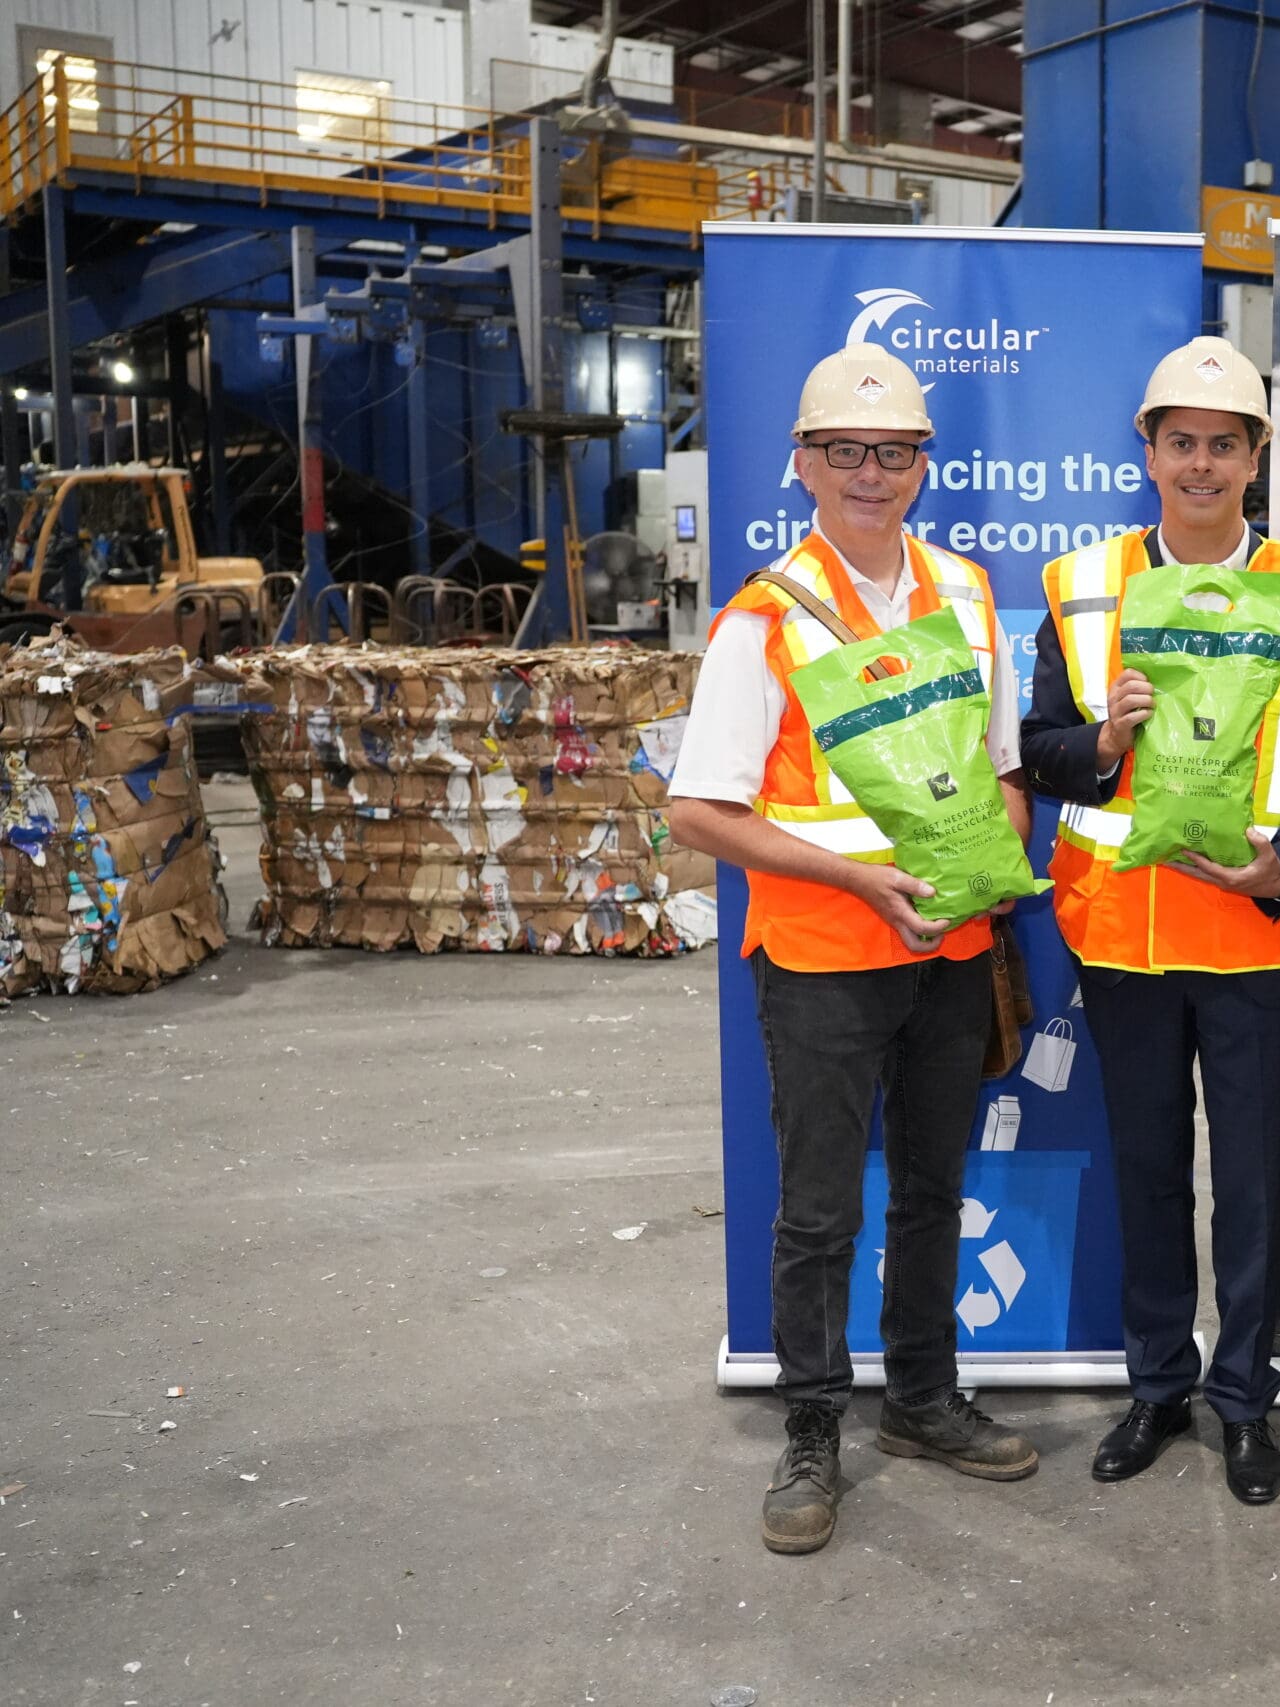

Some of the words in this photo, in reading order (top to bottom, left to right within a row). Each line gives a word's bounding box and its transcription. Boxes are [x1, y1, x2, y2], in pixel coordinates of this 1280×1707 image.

[915, 355, 1020, 374] materials
[1061, 453, 1142, 493] the
[1152, 764, 1179, 774] C'EST
[913, 821, 940, 837] C'EST
[944, 799, 994, 826] NESPRESSO
